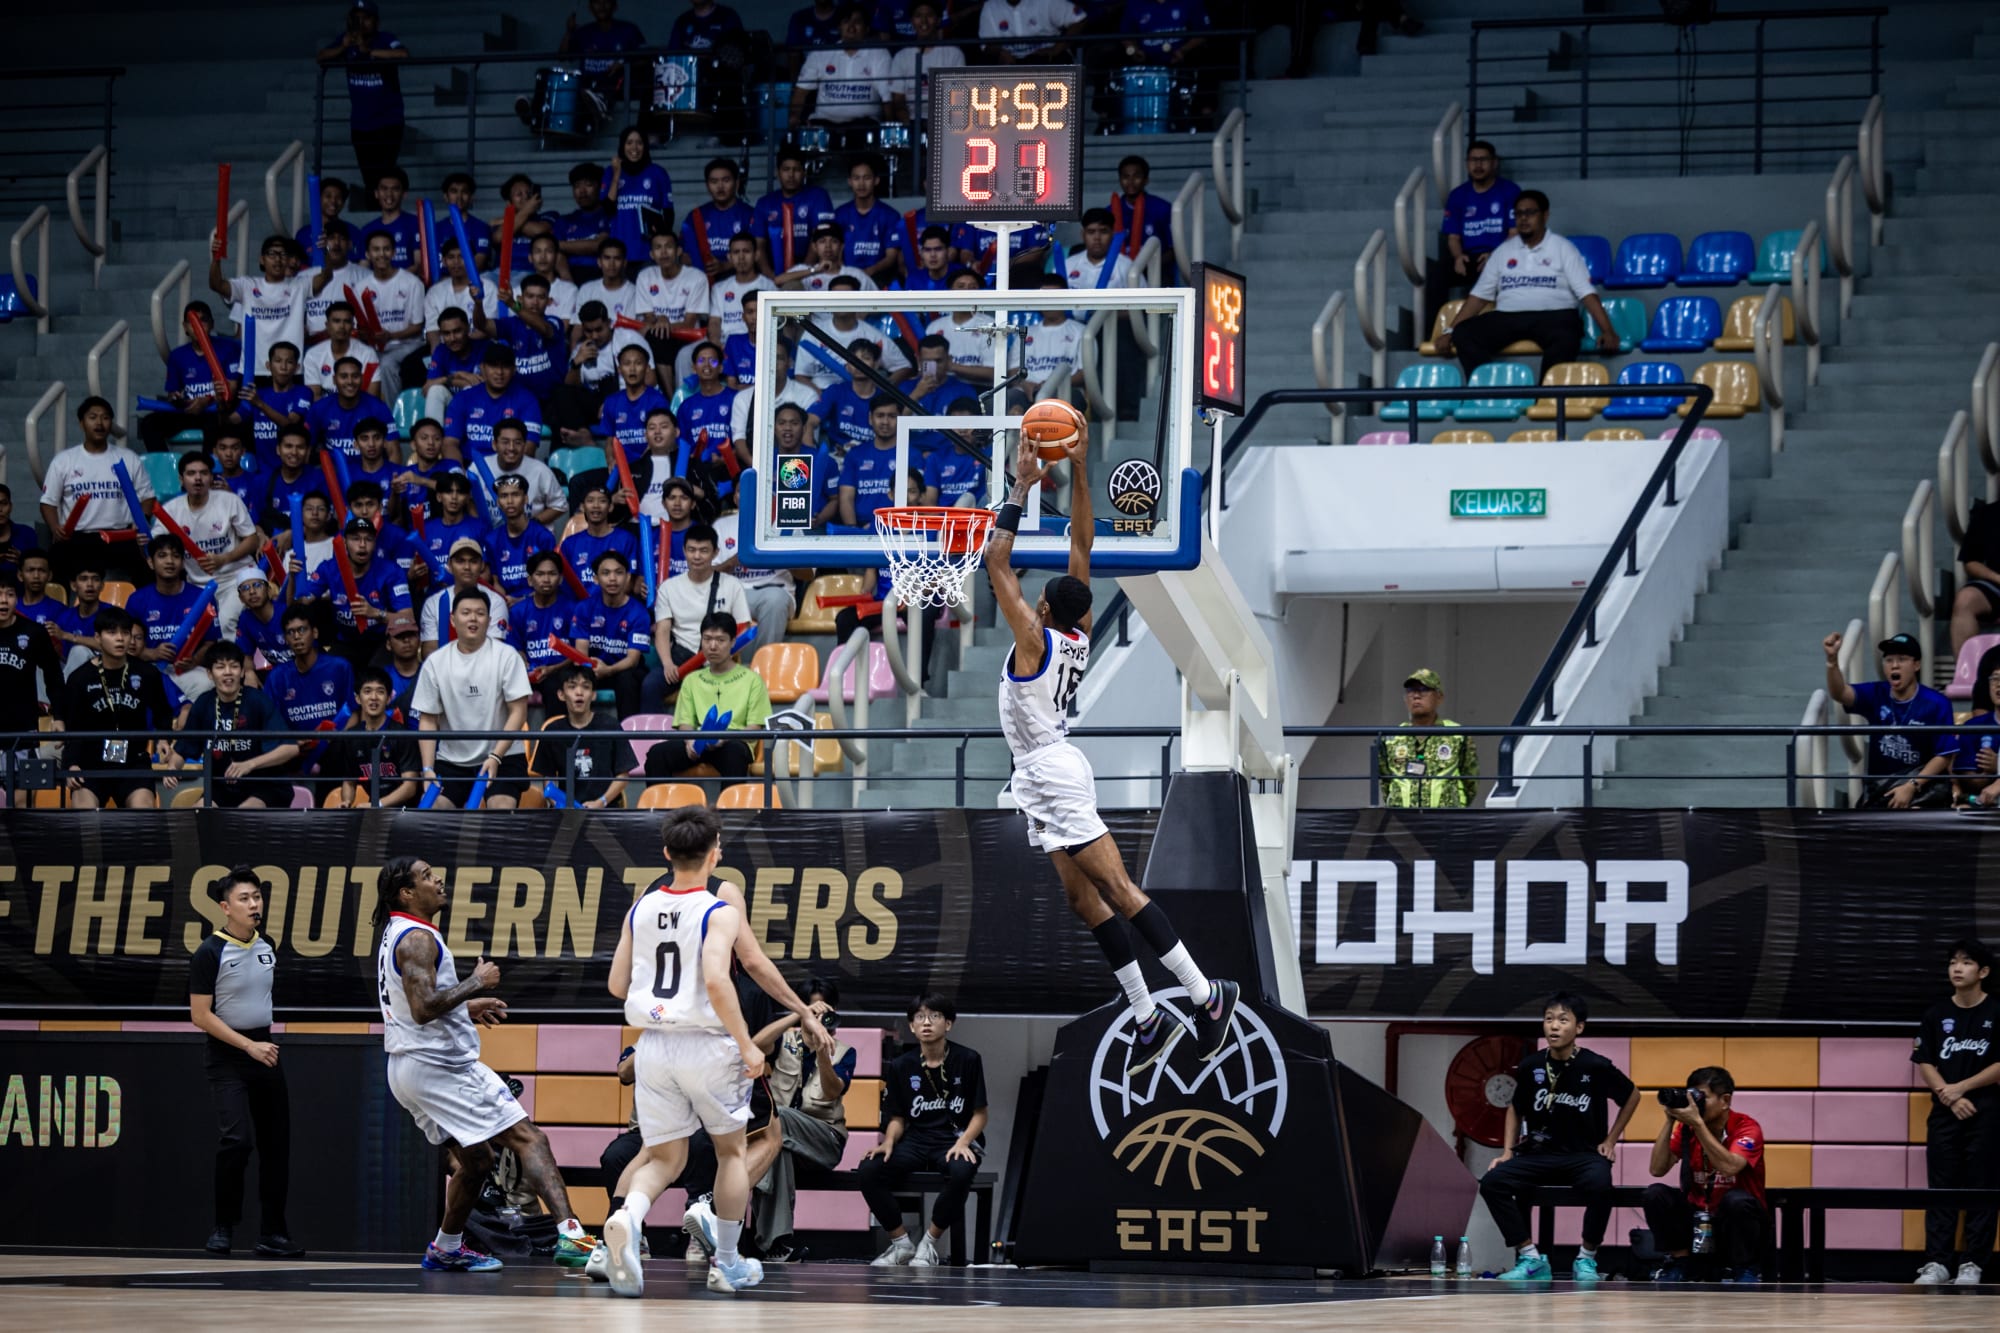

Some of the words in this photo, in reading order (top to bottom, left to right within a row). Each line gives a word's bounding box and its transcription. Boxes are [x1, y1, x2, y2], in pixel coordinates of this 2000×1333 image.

[971, 82, 1068, 130] 4:52
[782, 497, 806, 510] FIBA
[1453, 491, 1525, 514] KELUAR
[1114, 519, 1153, 532] EAST
[287, 700, 337, 716] SOUTHERN
[288, 709, 338, 723] VOLUNTEERS
[31, 866, 171, 956] THE
[652, 941, 682, 999] 0
[1115, 1207, 1269, 1253] EAST
